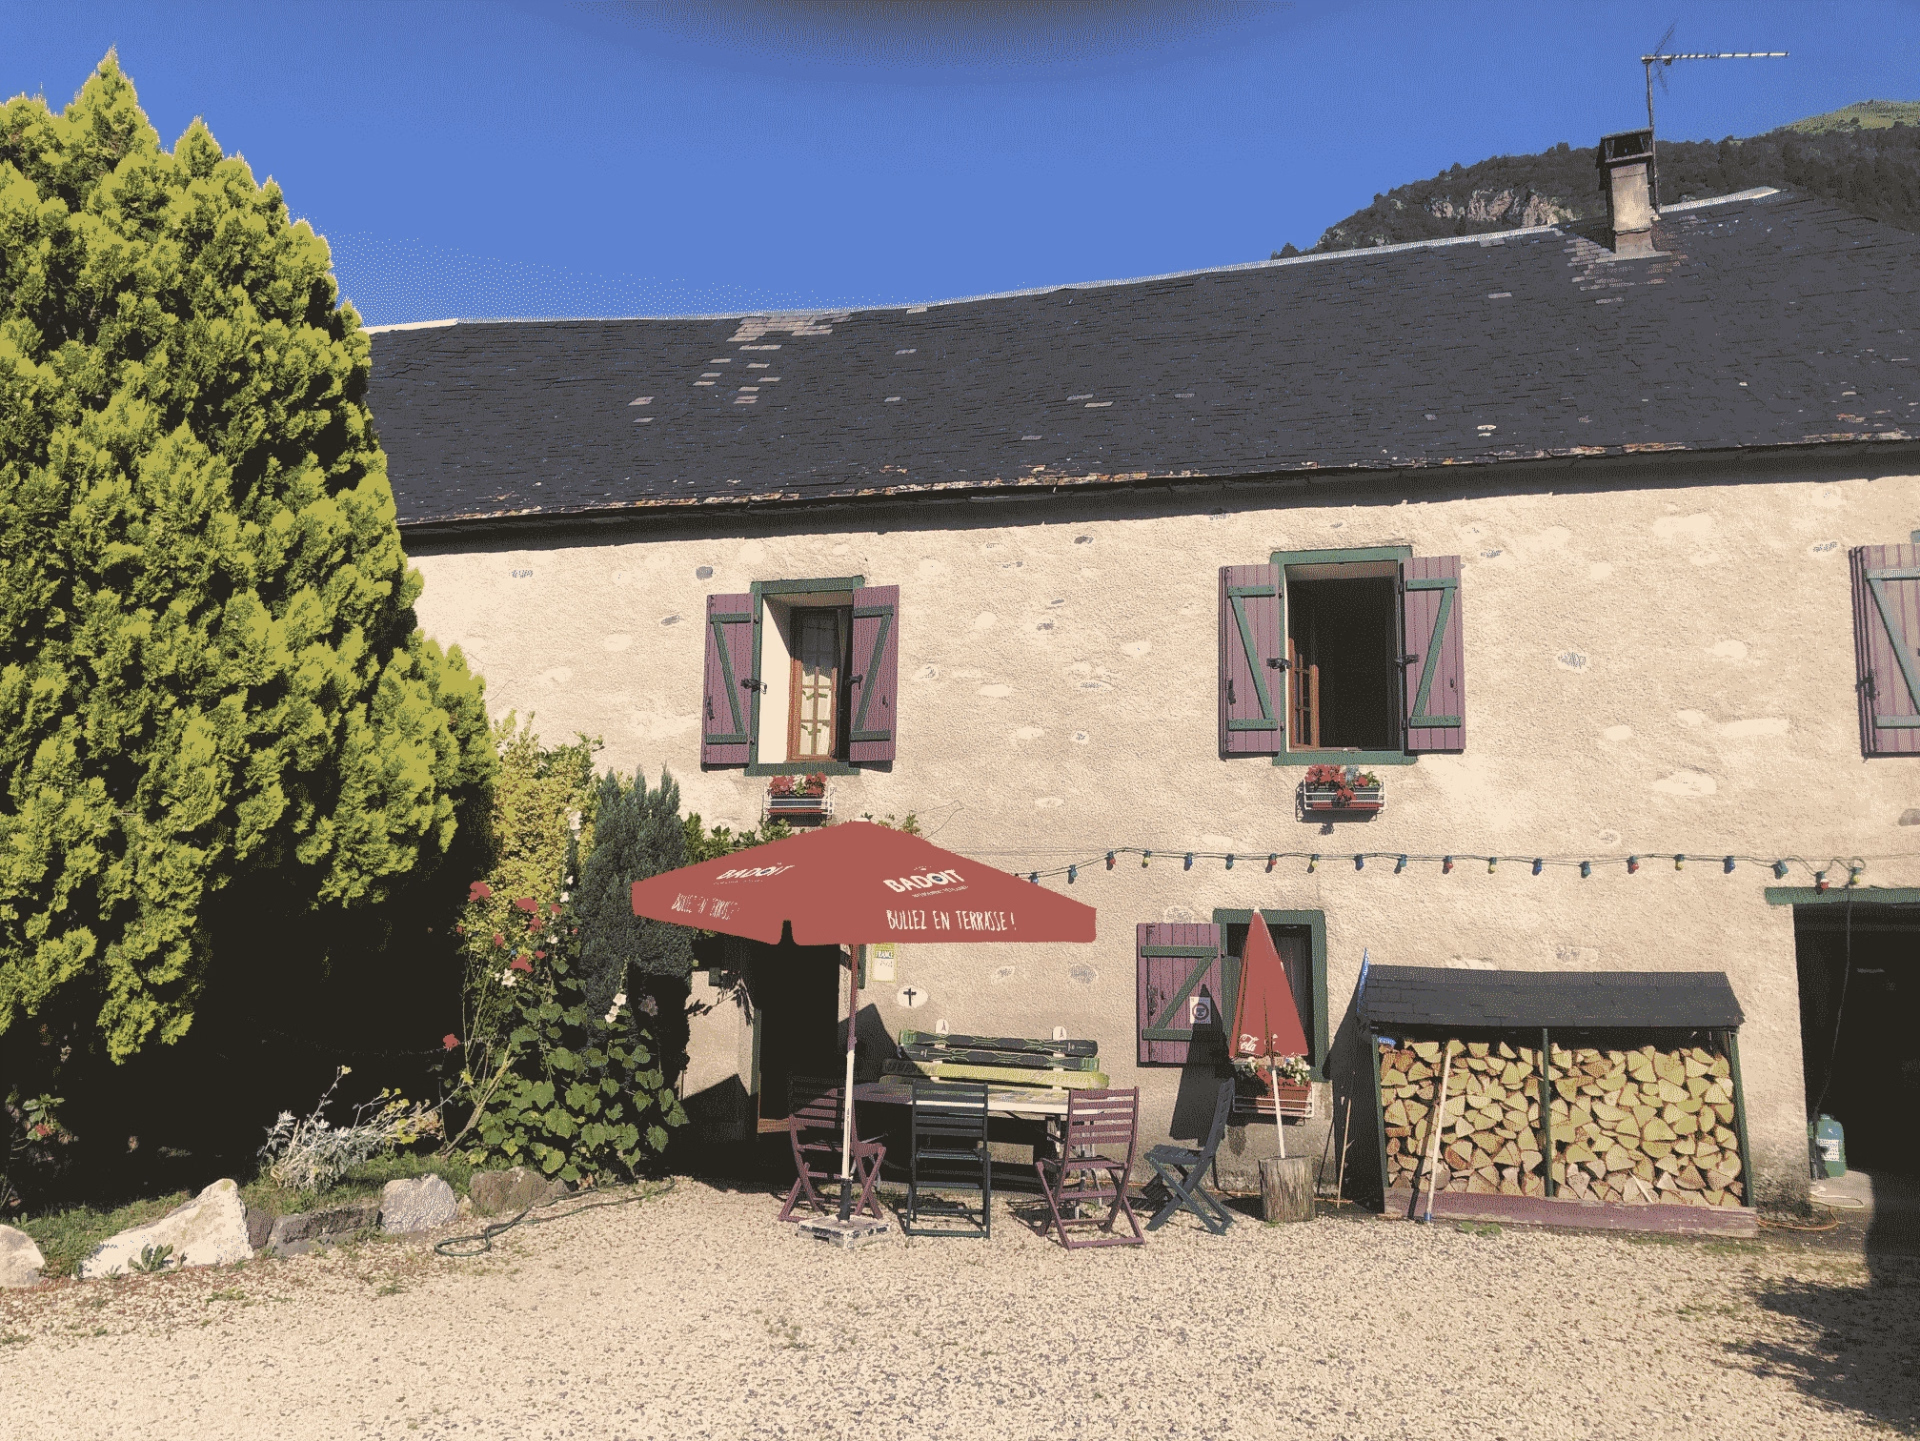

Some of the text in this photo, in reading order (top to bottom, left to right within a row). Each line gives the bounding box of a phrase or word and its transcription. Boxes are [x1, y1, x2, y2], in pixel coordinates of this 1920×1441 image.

[716, 865, 795, 880] BADOIT
[883, 869, 965, 893] BADOIT
[886, 909, 927, 930] BULLEZ
[932, 910, 950, 931] EN
[955, 910, 1008, 931] TERRASSE
